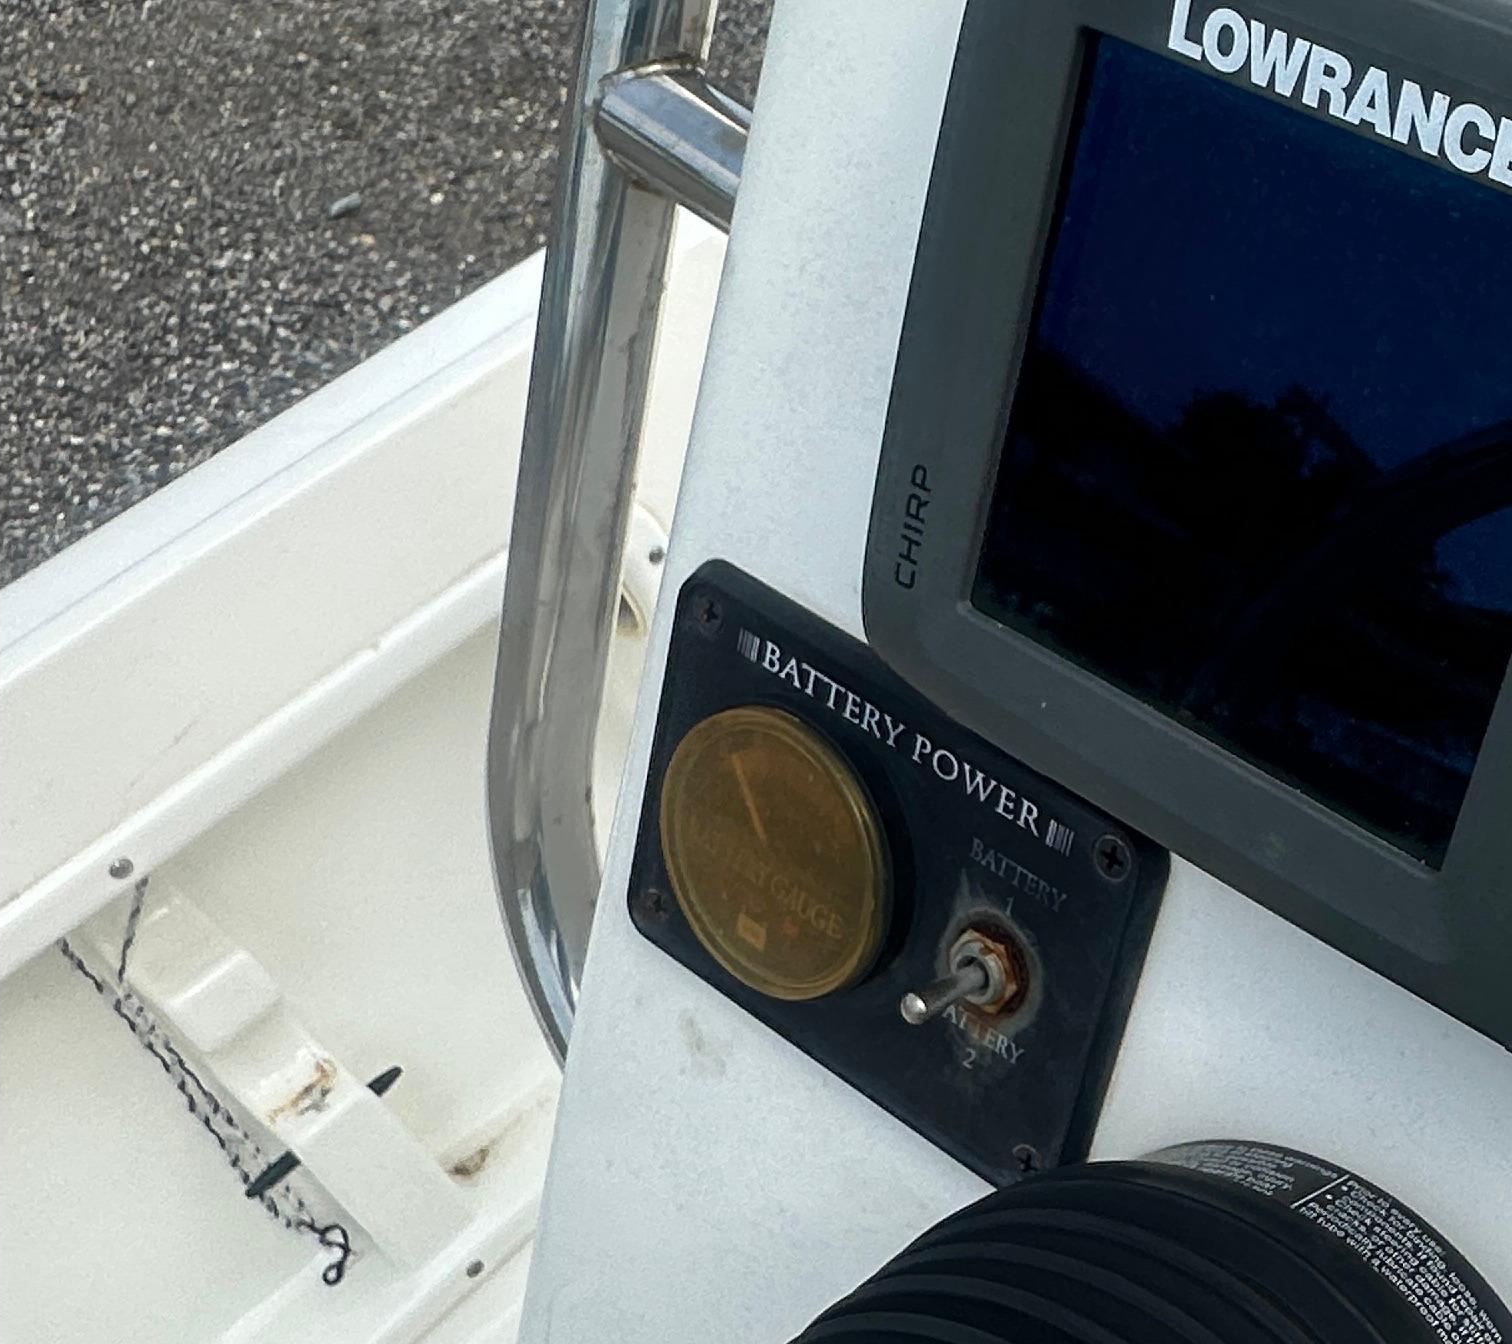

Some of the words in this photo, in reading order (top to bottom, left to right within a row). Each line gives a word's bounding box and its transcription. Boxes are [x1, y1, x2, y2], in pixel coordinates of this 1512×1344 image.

[894, 463, 931, 592] CHIRP
[762, 640, 906, 748] BATTERY
[912, 733, 1040, 838] POWER
[969, 836, 1068, 913] BATTERY
[941, 1005, 1025, 1065] ATTERY
[962, 1047, 977, 1070] 2
